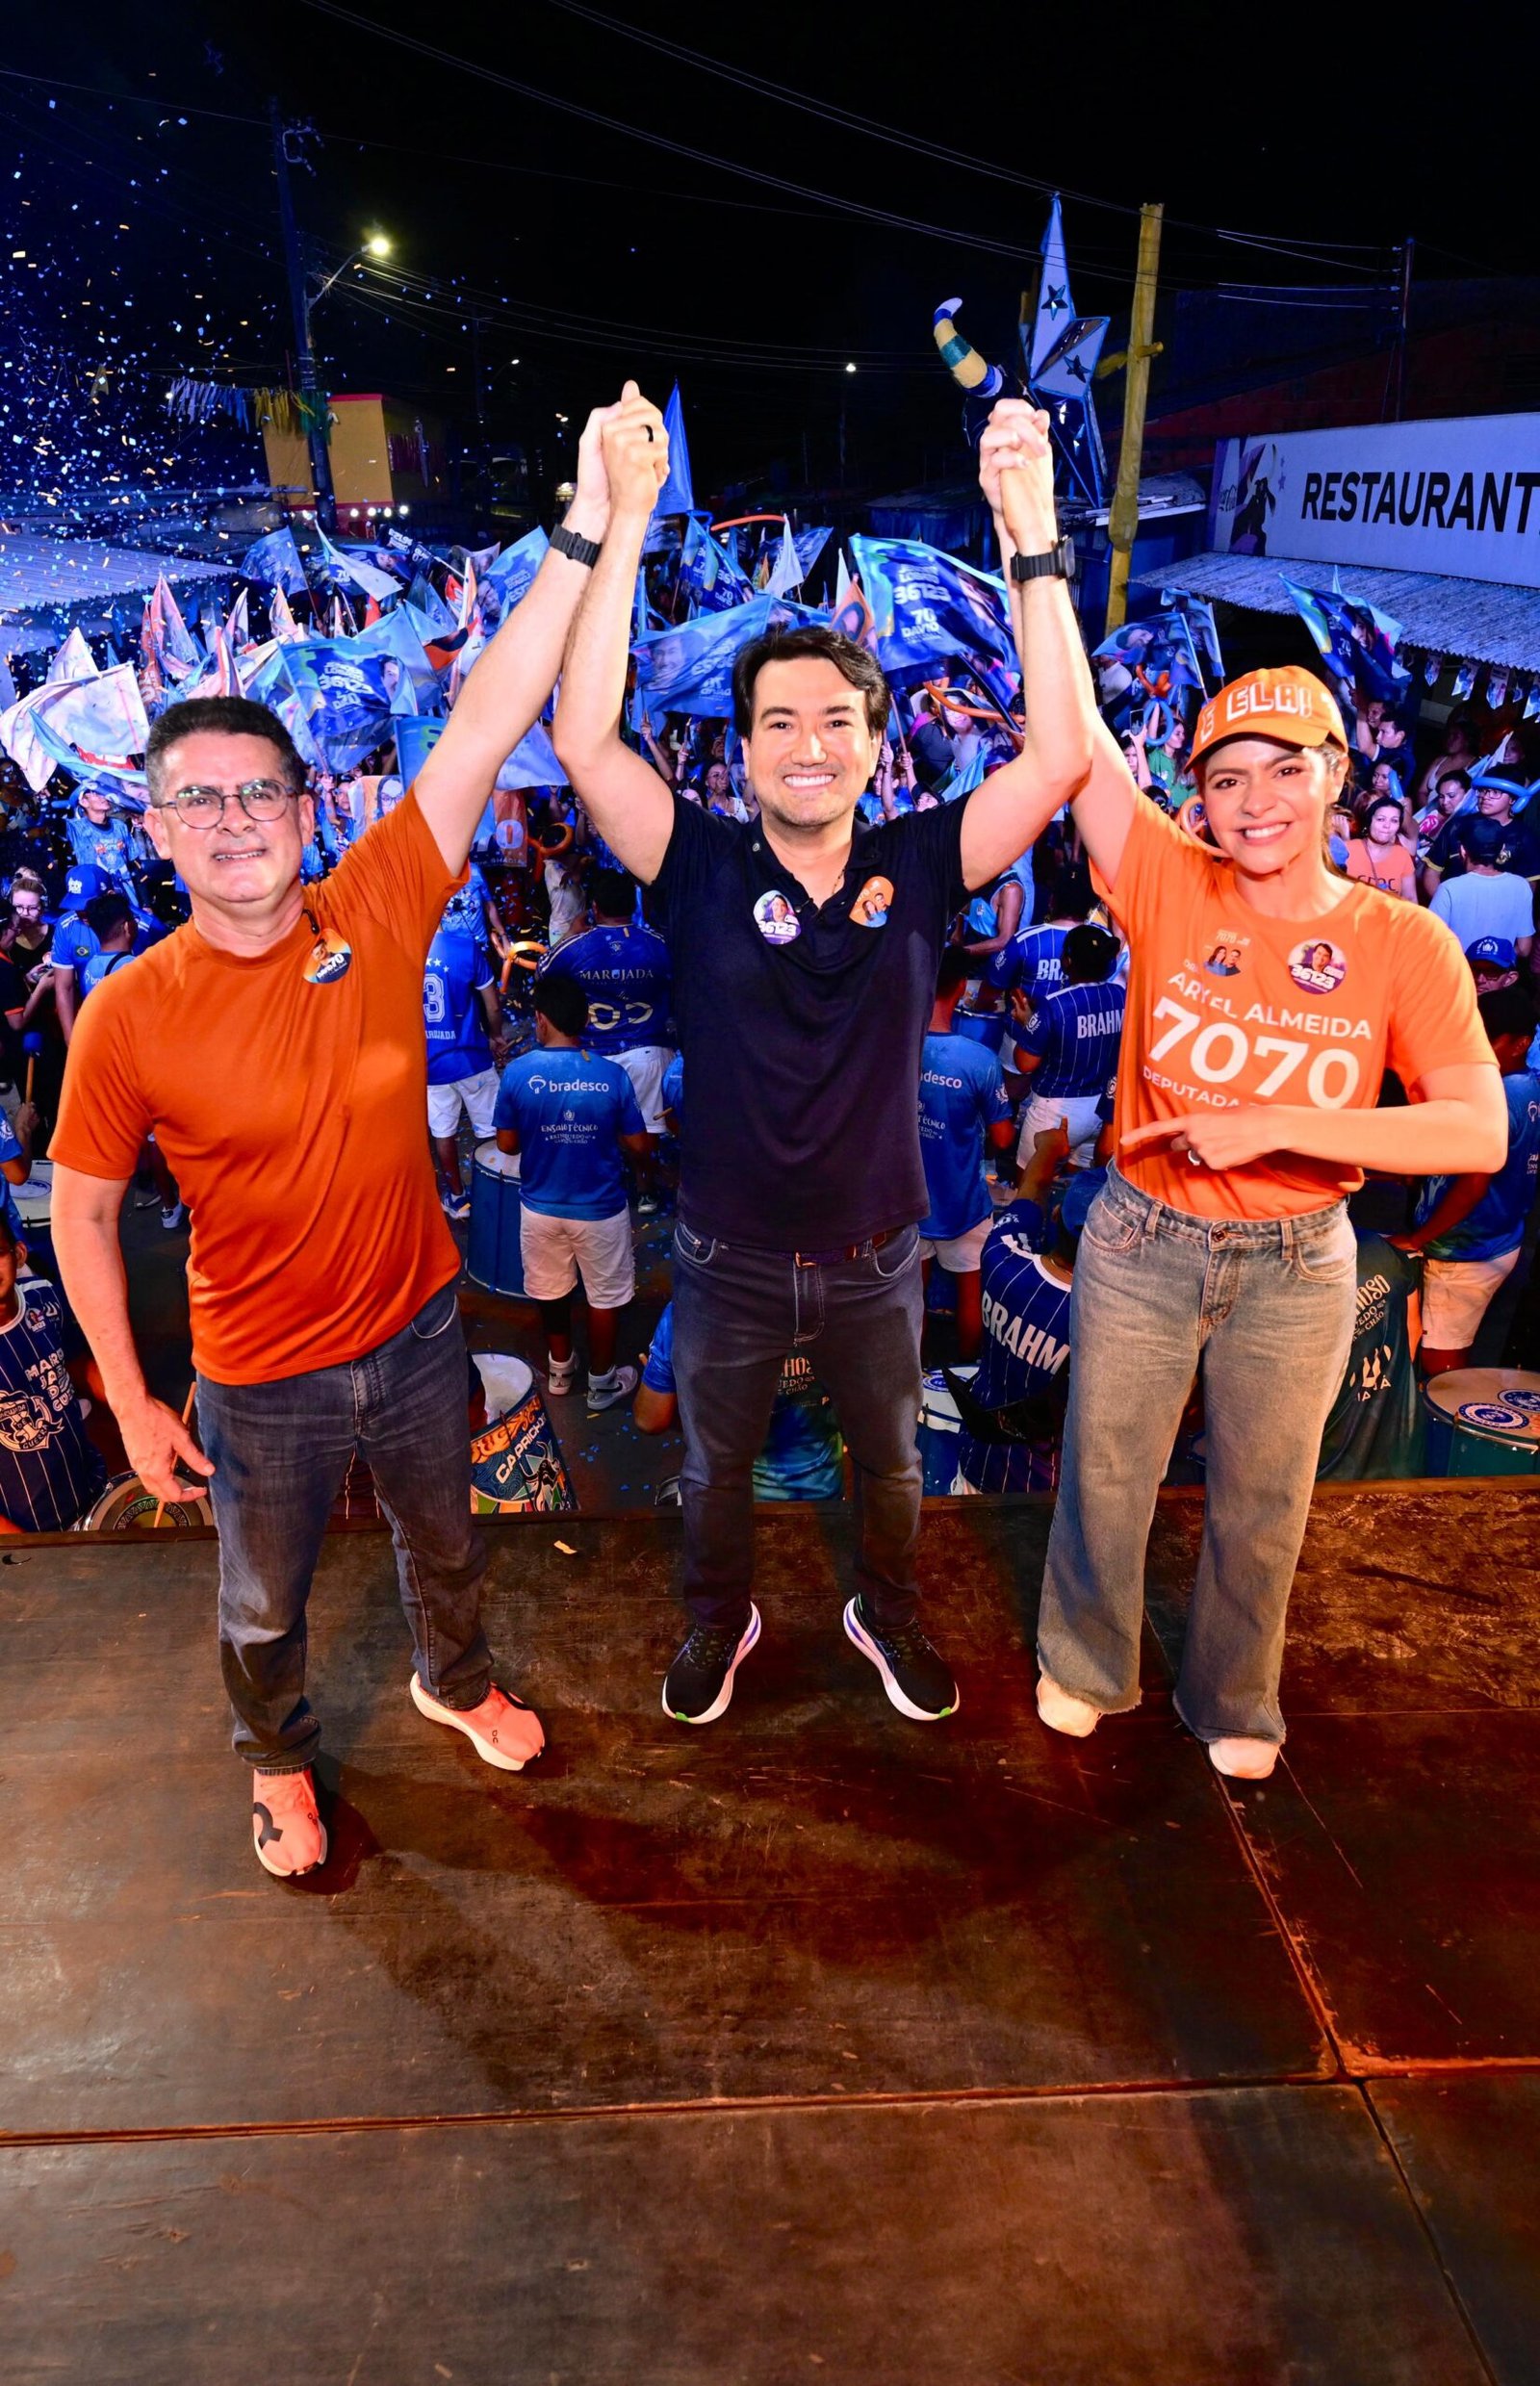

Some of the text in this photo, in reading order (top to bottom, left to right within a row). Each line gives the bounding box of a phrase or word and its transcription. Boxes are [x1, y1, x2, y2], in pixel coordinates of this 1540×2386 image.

[1301, 472, 1540, 533] RESTAURANT
[893, 581, 952, 605] 36123
[910, 607, 937, 624] 70
[901, 621, 940, 637] DAVID
[1226, 681, 1313, 722] ELA!
[757, 920, 797, 936] 36123
[579, 968, 654, 981] MARUJADA
[1291, 964, 1336, 990] 36123
[1077, 1009, 1126, 1039] BRAHM
[1244, 1002, 1373, 1040] ALMEIDA
[1148, 995, 1360, 1111] 7070
[549, 1079, 610, 1093] bradesco
[920, 1069, 962, 1089] desco
[1142, 1064, 1241, 1108] DEPUTADA
[982, 1290, 1071, 1374] BRAHM
[22, 1424, 49, 1450] GUERRA
